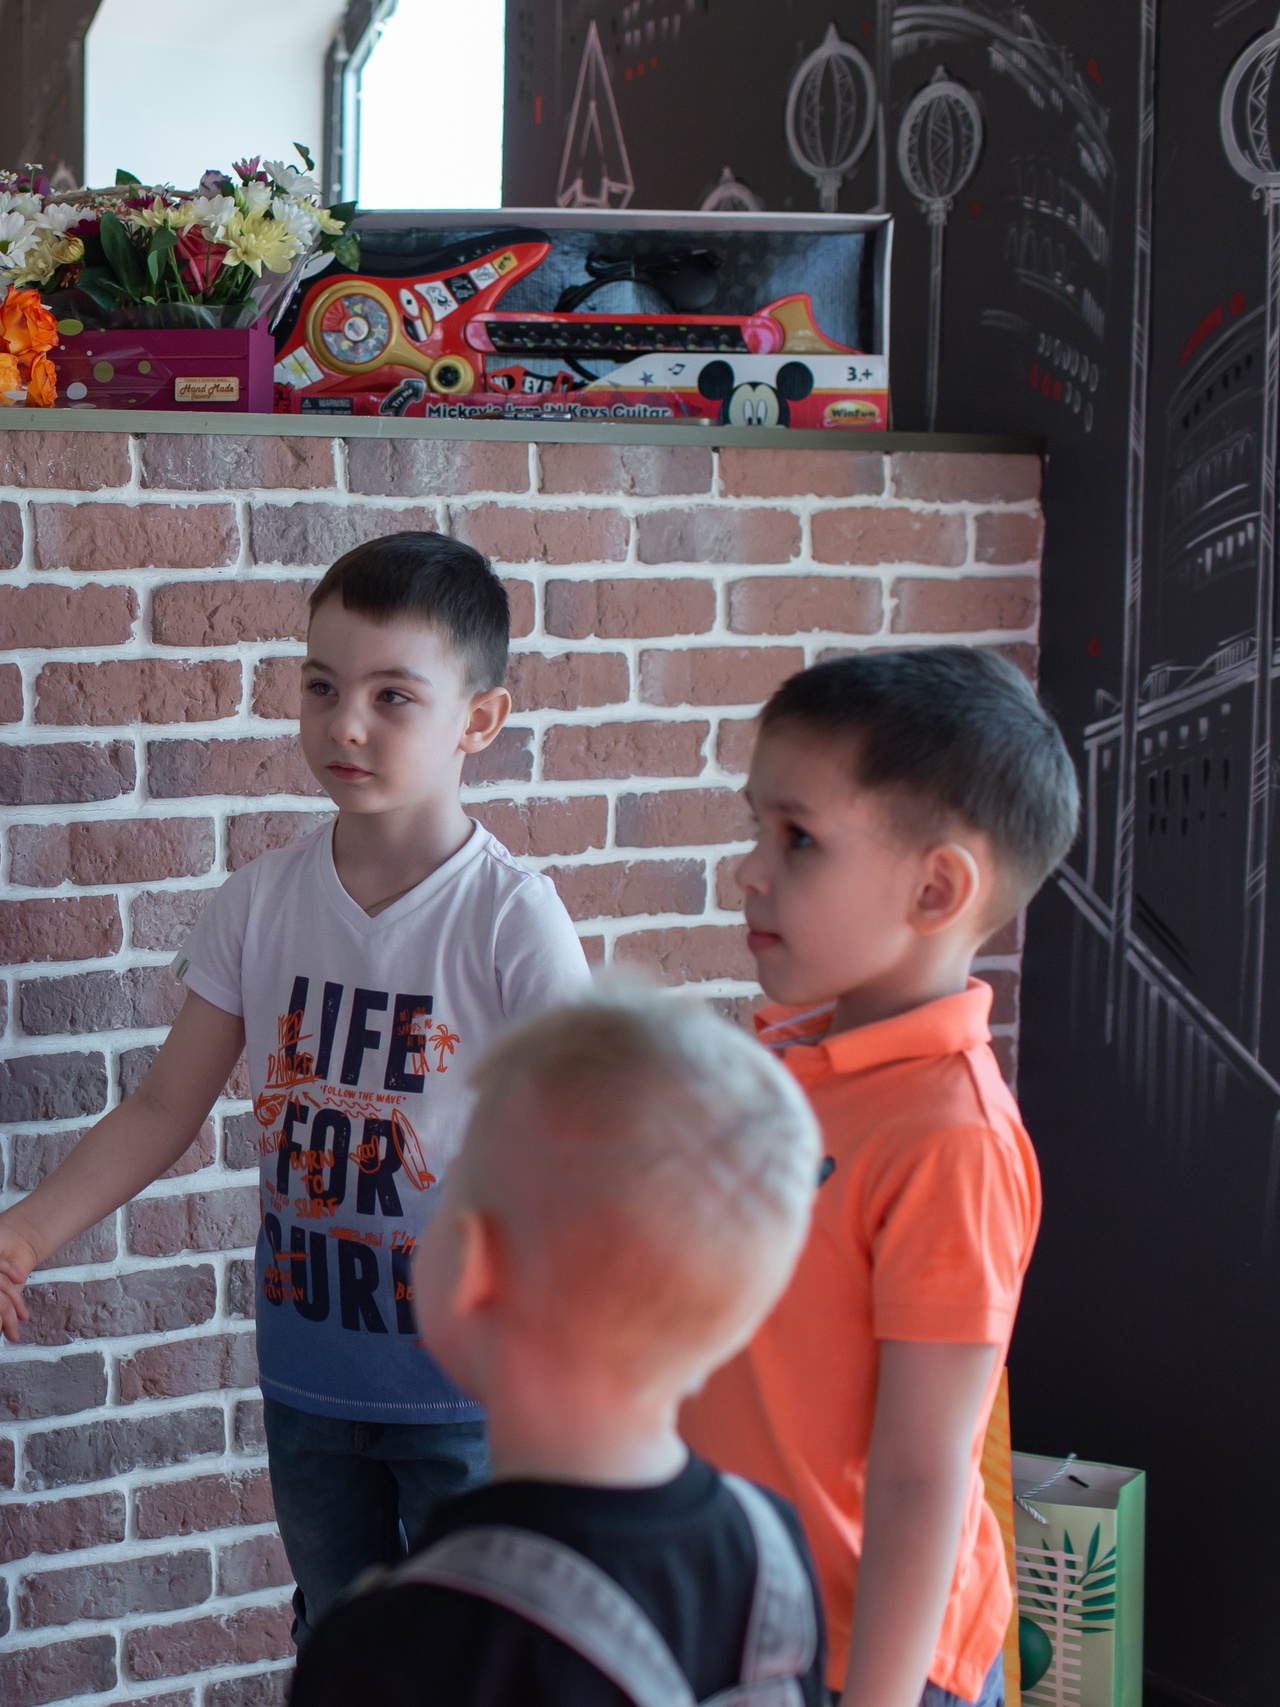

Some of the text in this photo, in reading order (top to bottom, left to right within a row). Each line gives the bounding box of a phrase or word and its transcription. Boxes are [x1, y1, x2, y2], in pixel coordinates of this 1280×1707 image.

[179, 383, 234, 398] Hand Made
[391, 387, 414, 409] Try Me
[568, 404, 608, 418] Keys
[613, 404, 671, 418] Guitar
[284, 975, 433, 1094] LIFE
[359, 1091, 374, 1101] THE
[277, 1100, 405, 1217] FOR
[290, 1149, 335, 1172] BORN
[301, 1174, 325, 1195] TO
[294, 1197, 339, 1220] SURF
